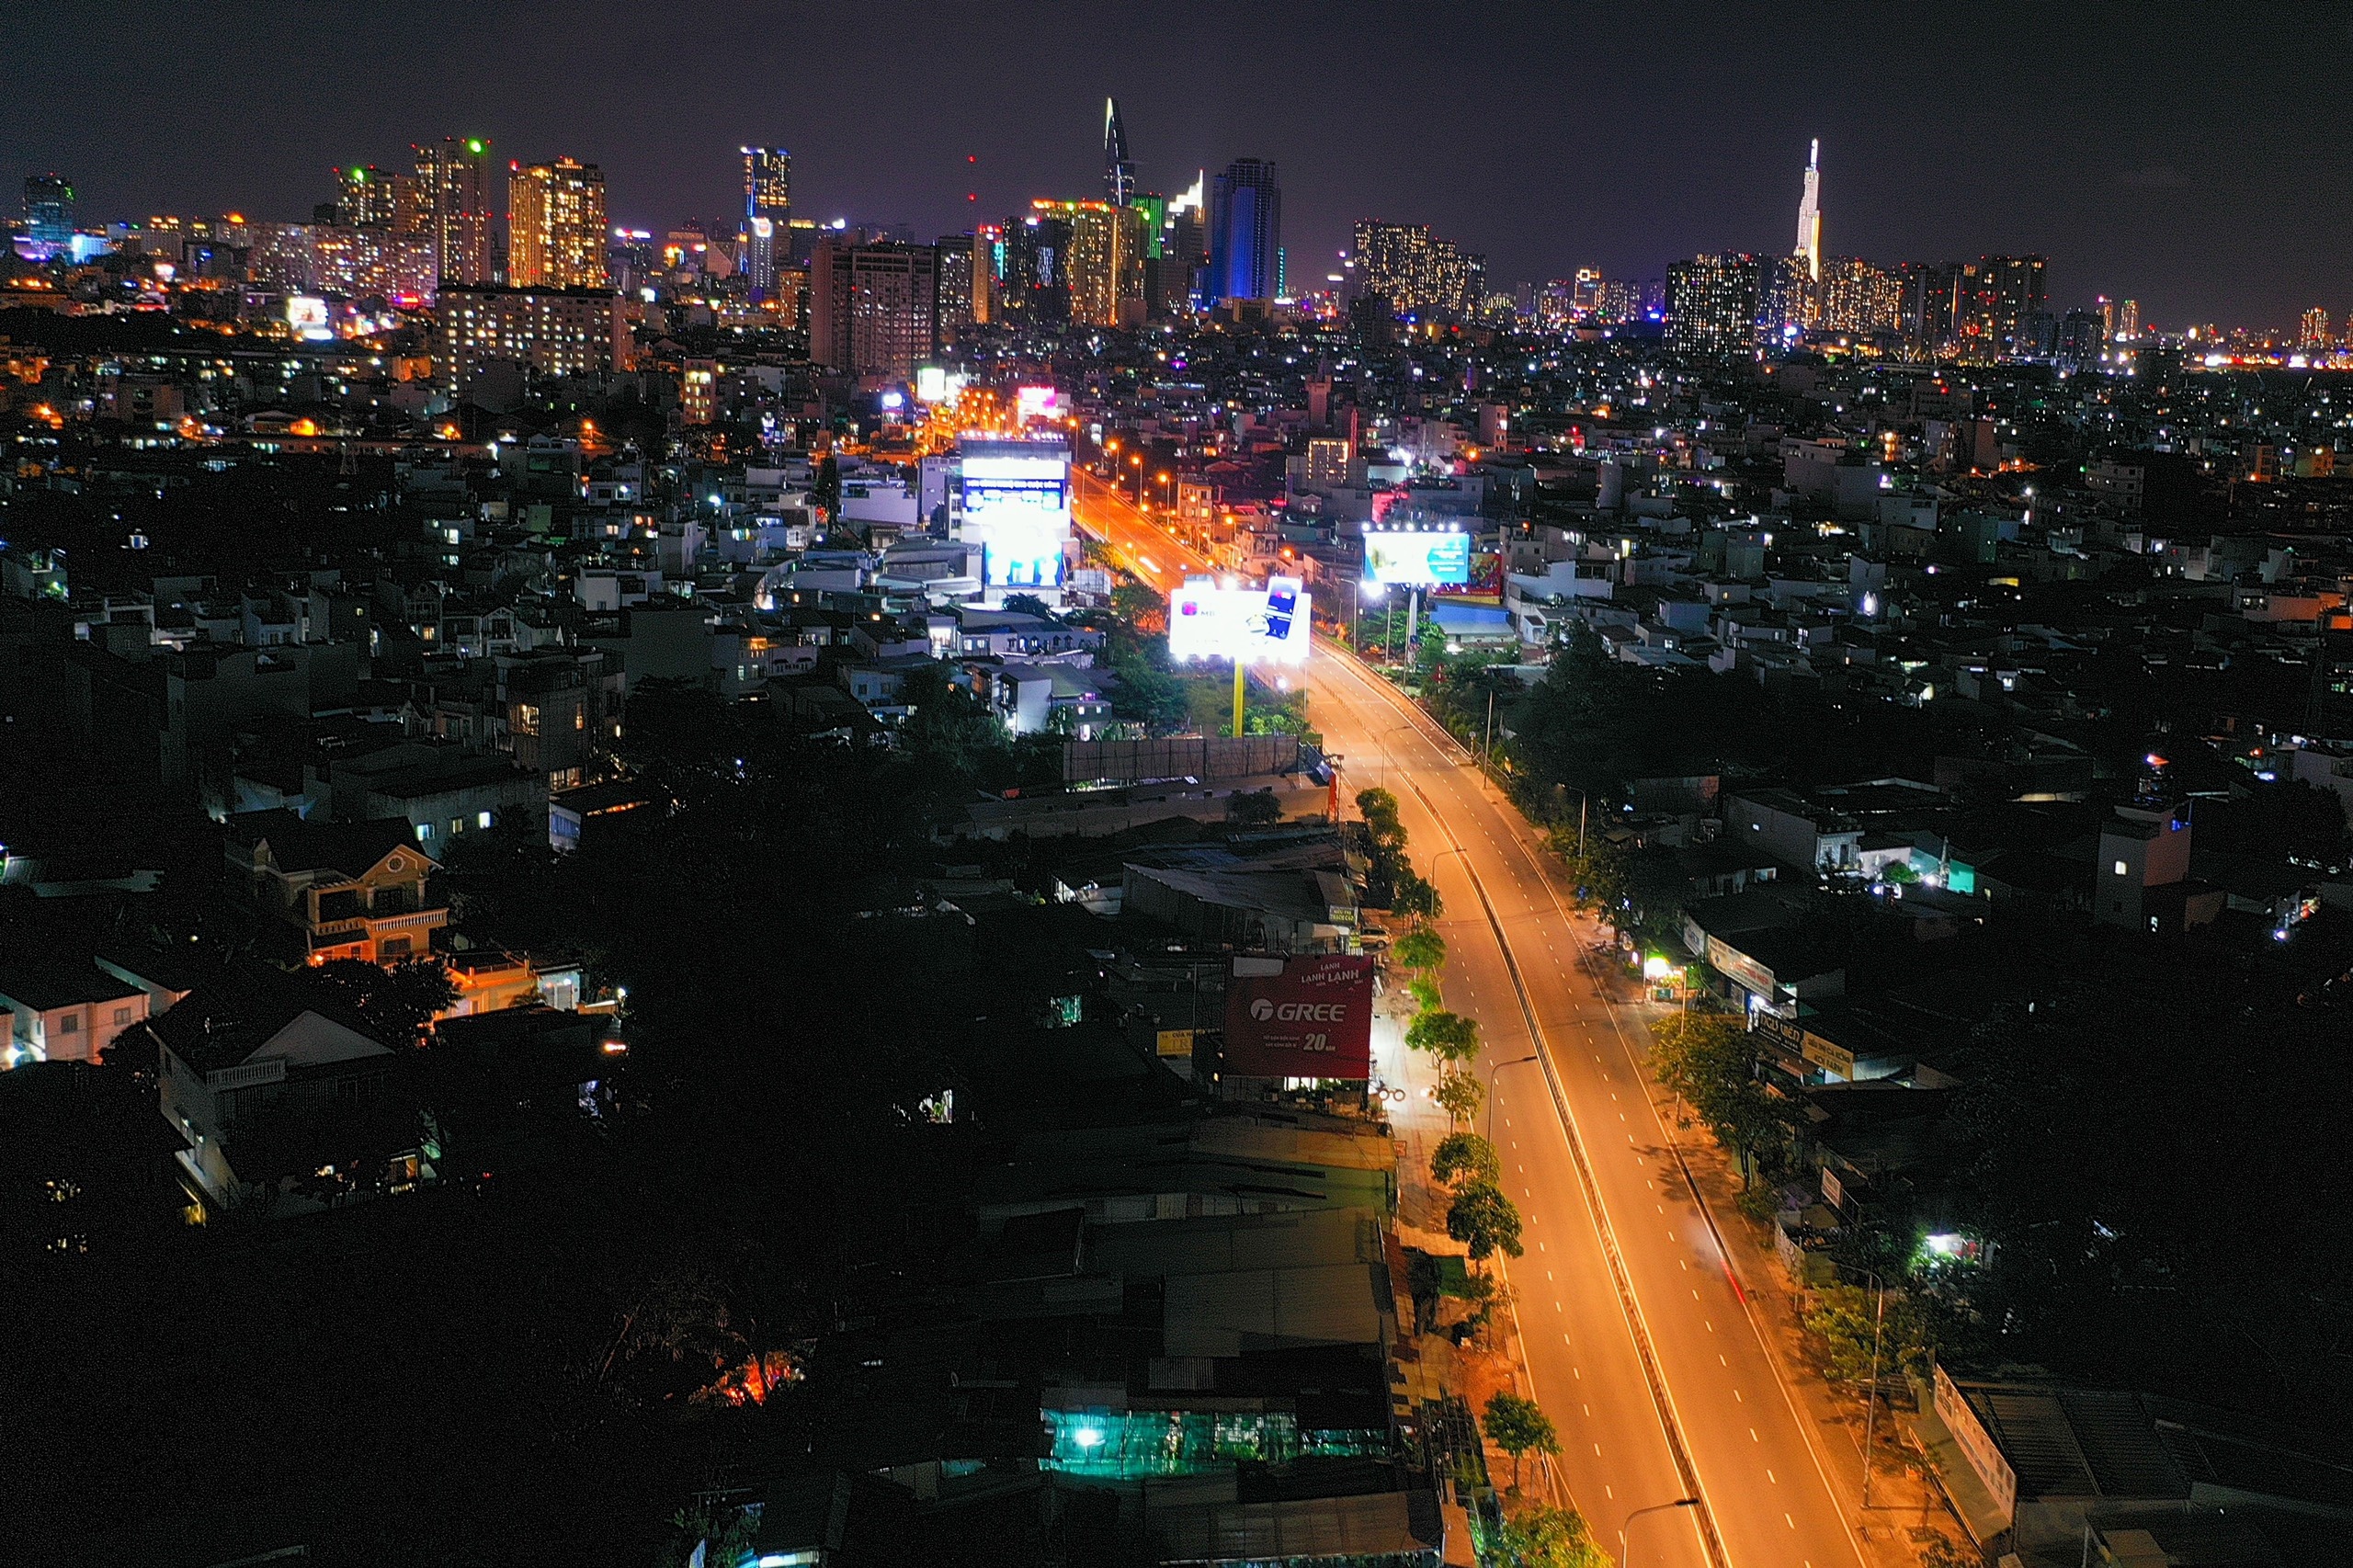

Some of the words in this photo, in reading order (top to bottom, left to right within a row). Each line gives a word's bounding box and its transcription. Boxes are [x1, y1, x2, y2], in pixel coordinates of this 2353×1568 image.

[1320, 962, 1340, 972] LẠNH
[1302, 972, 1324, 984] LẠNH
[1327, 970, 1359, 984] LẠNH
[1277, 1004, 1347, 1022] GREE
[1303, 1033, 1327, 1051] 20
